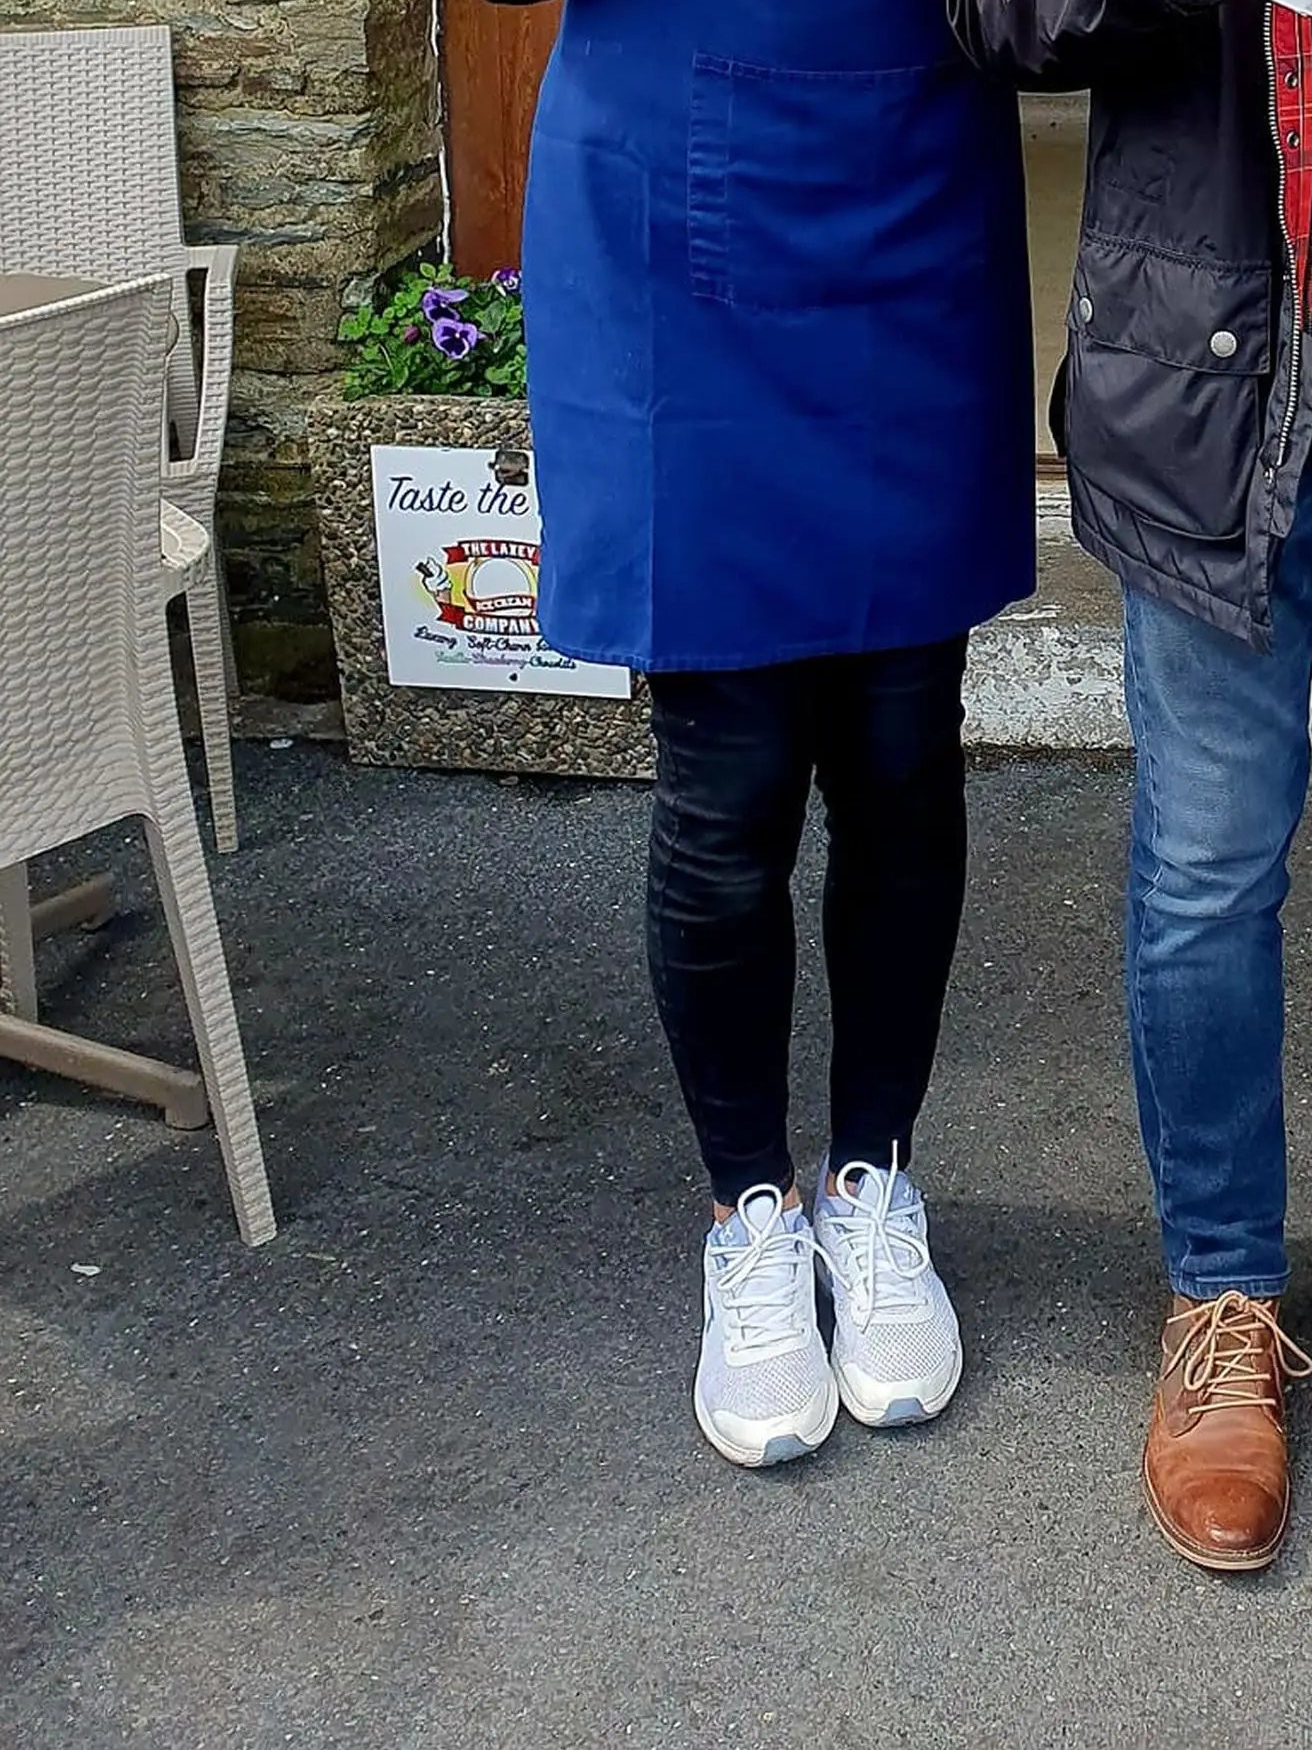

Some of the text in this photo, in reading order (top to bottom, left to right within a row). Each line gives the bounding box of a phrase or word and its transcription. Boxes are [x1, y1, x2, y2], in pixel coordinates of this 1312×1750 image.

[388, 476, 530, 516] Taste the
[461, 541, 535, 559] THE LAXEY
